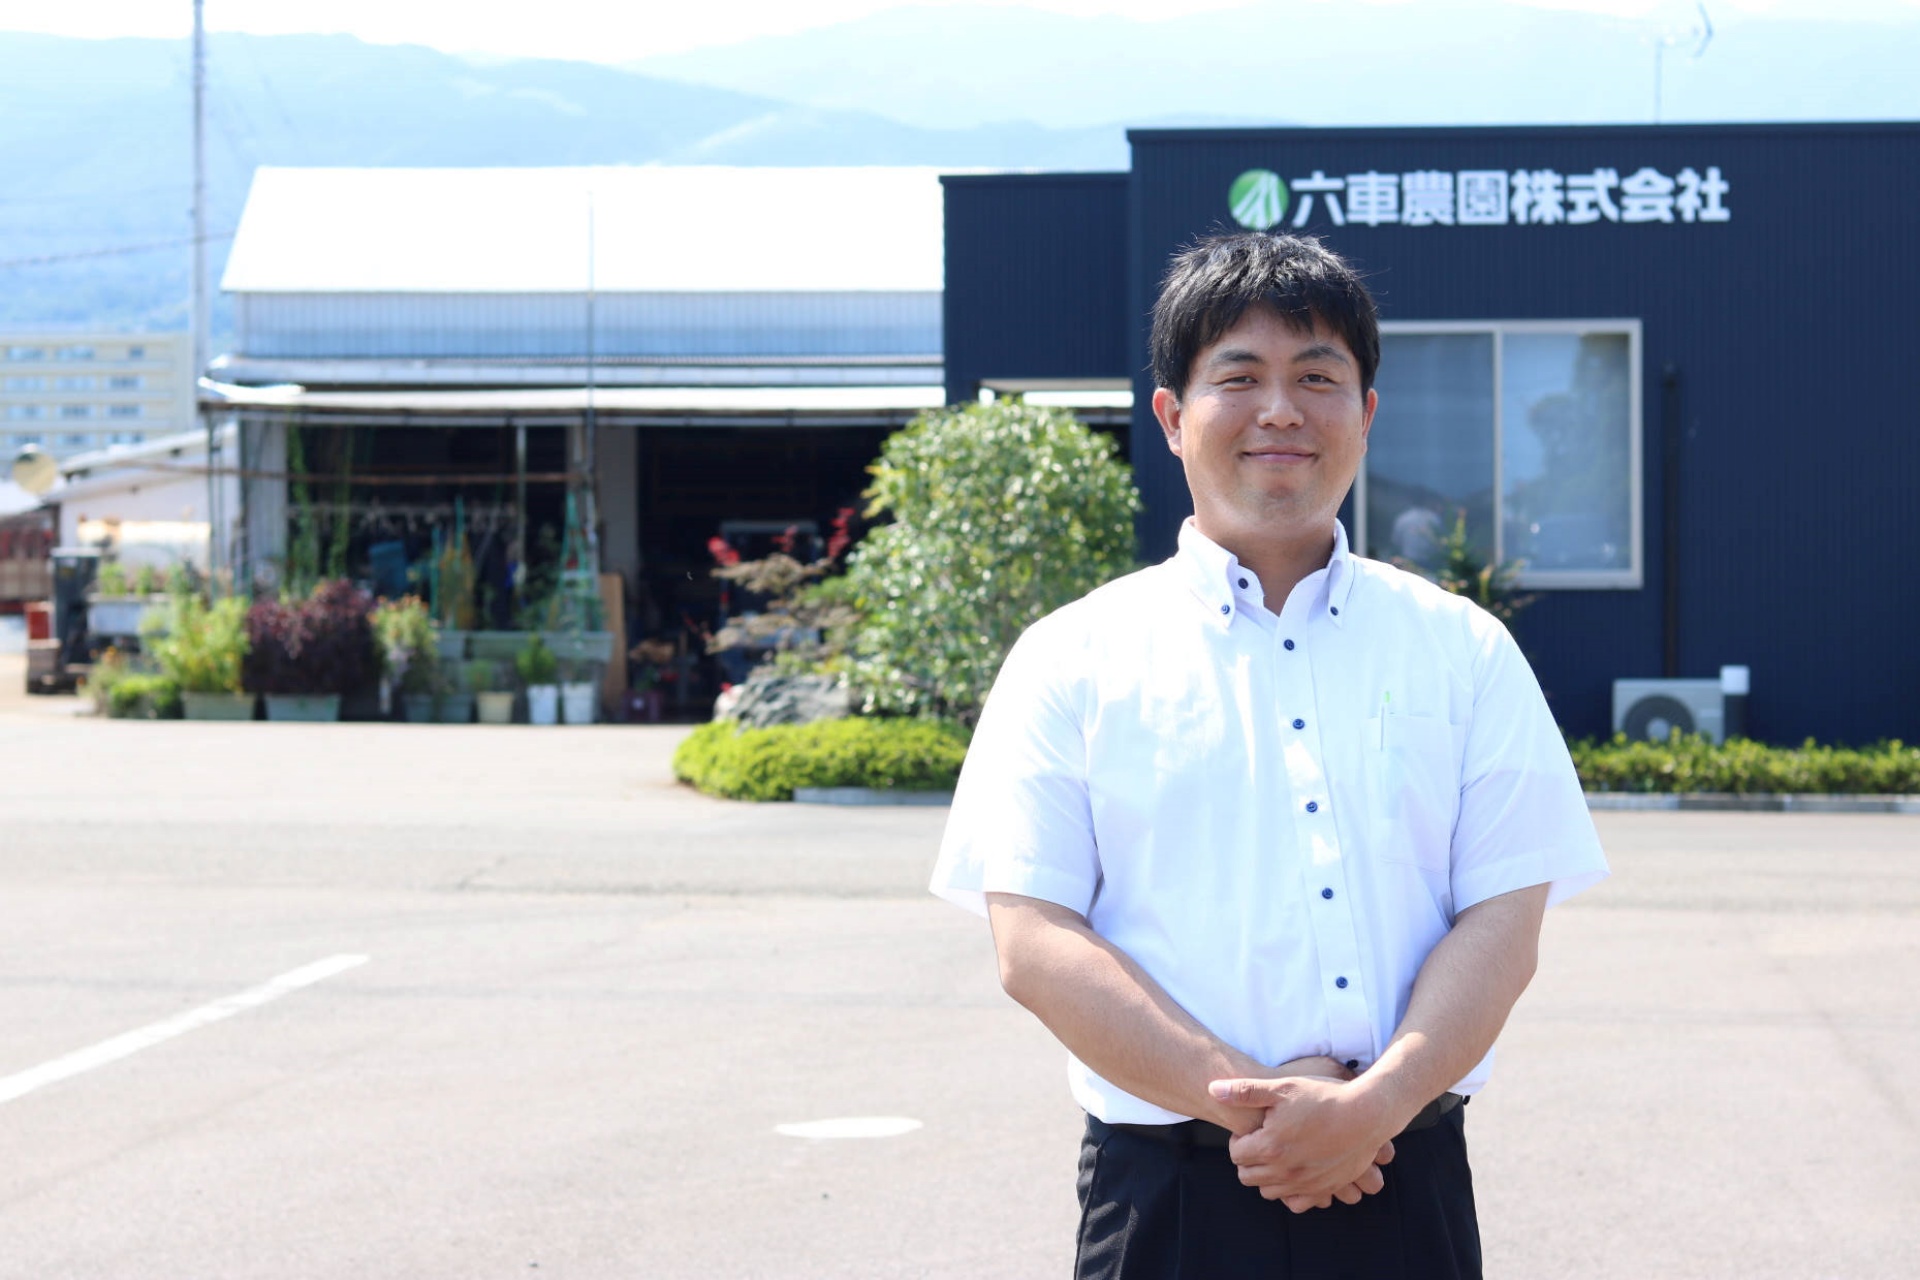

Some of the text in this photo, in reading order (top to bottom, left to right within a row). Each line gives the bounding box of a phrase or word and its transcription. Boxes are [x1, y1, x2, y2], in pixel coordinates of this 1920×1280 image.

[1290, 167, 1730, 227] 六車農園株式会社
